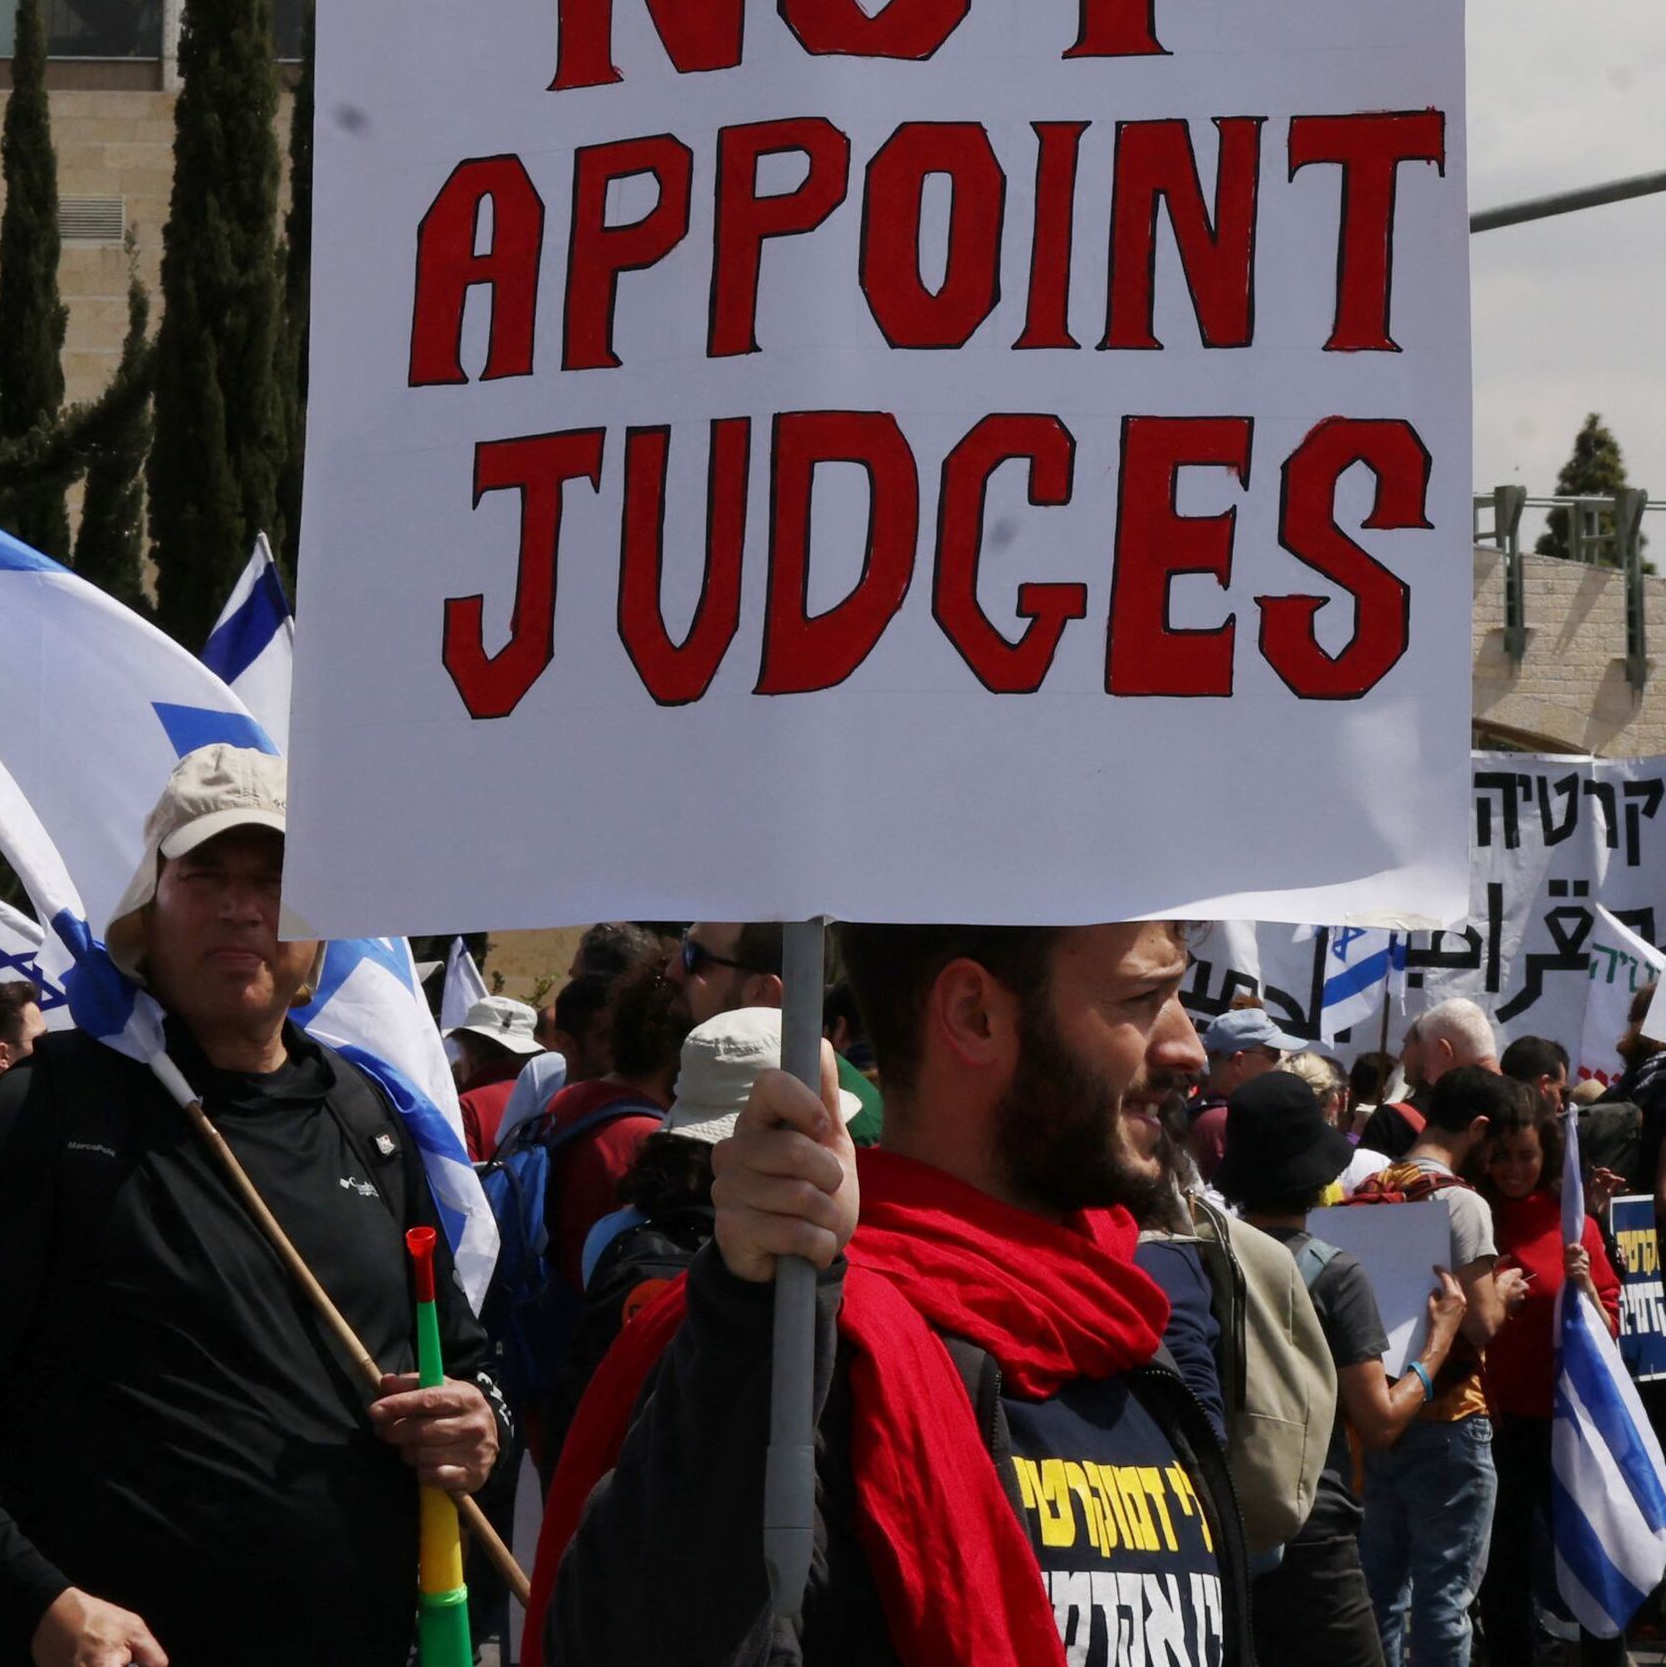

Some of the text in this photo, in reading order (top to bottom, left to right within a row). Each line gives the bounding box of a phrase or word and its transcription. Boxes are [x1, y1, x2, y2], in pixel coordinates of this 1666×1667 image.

[407, 107, 1448, 388] APPOINT
[441, 410, 1434, 720] JUDGES
[1011, 1456, 1180, 1558] דמוקרטי
